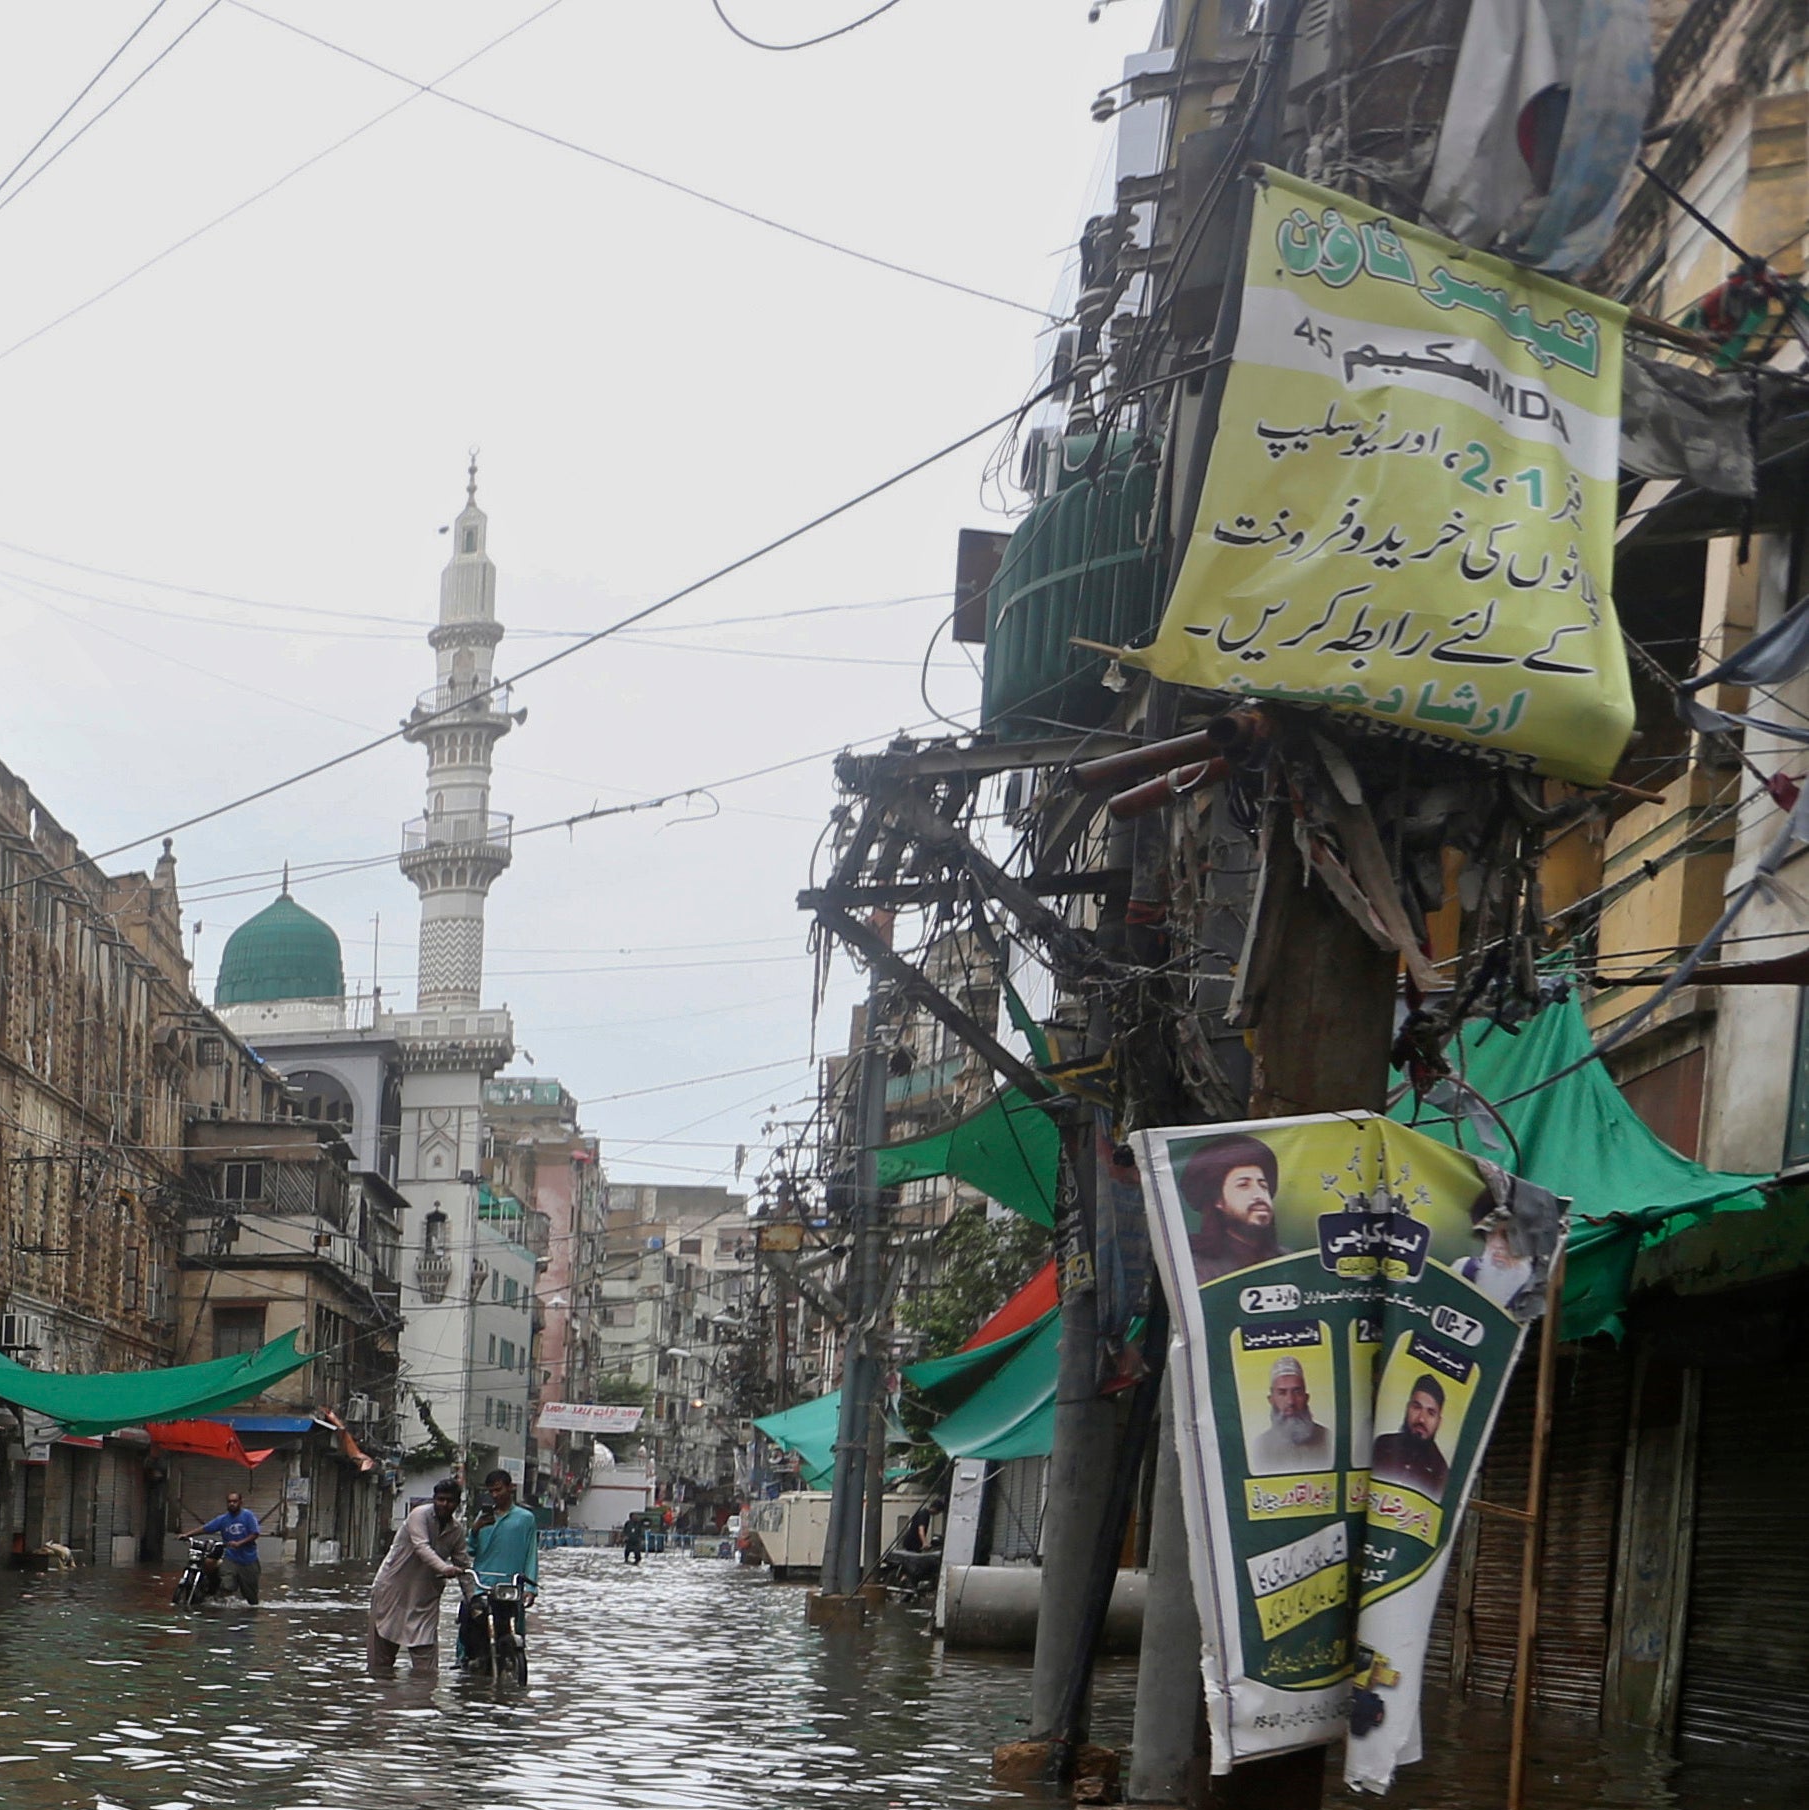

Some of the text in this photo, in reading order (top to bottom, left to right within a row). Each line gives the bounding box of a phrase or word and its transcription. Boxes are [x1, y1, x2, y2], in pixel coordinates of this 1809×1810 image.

[1277, 208, 1599, 378] تیسر ٹاؤن
[1293, 316, 1571, 445] MDA سکیم 45
[1385, 425, 1441, 455] اور
[1459, 522, 1518, 581] کی
[1316, 603, 1432, 671] رابطہ
[1521, 625, 1596, 675] کے
[1373, 682, 1528, 738] ارشاد
